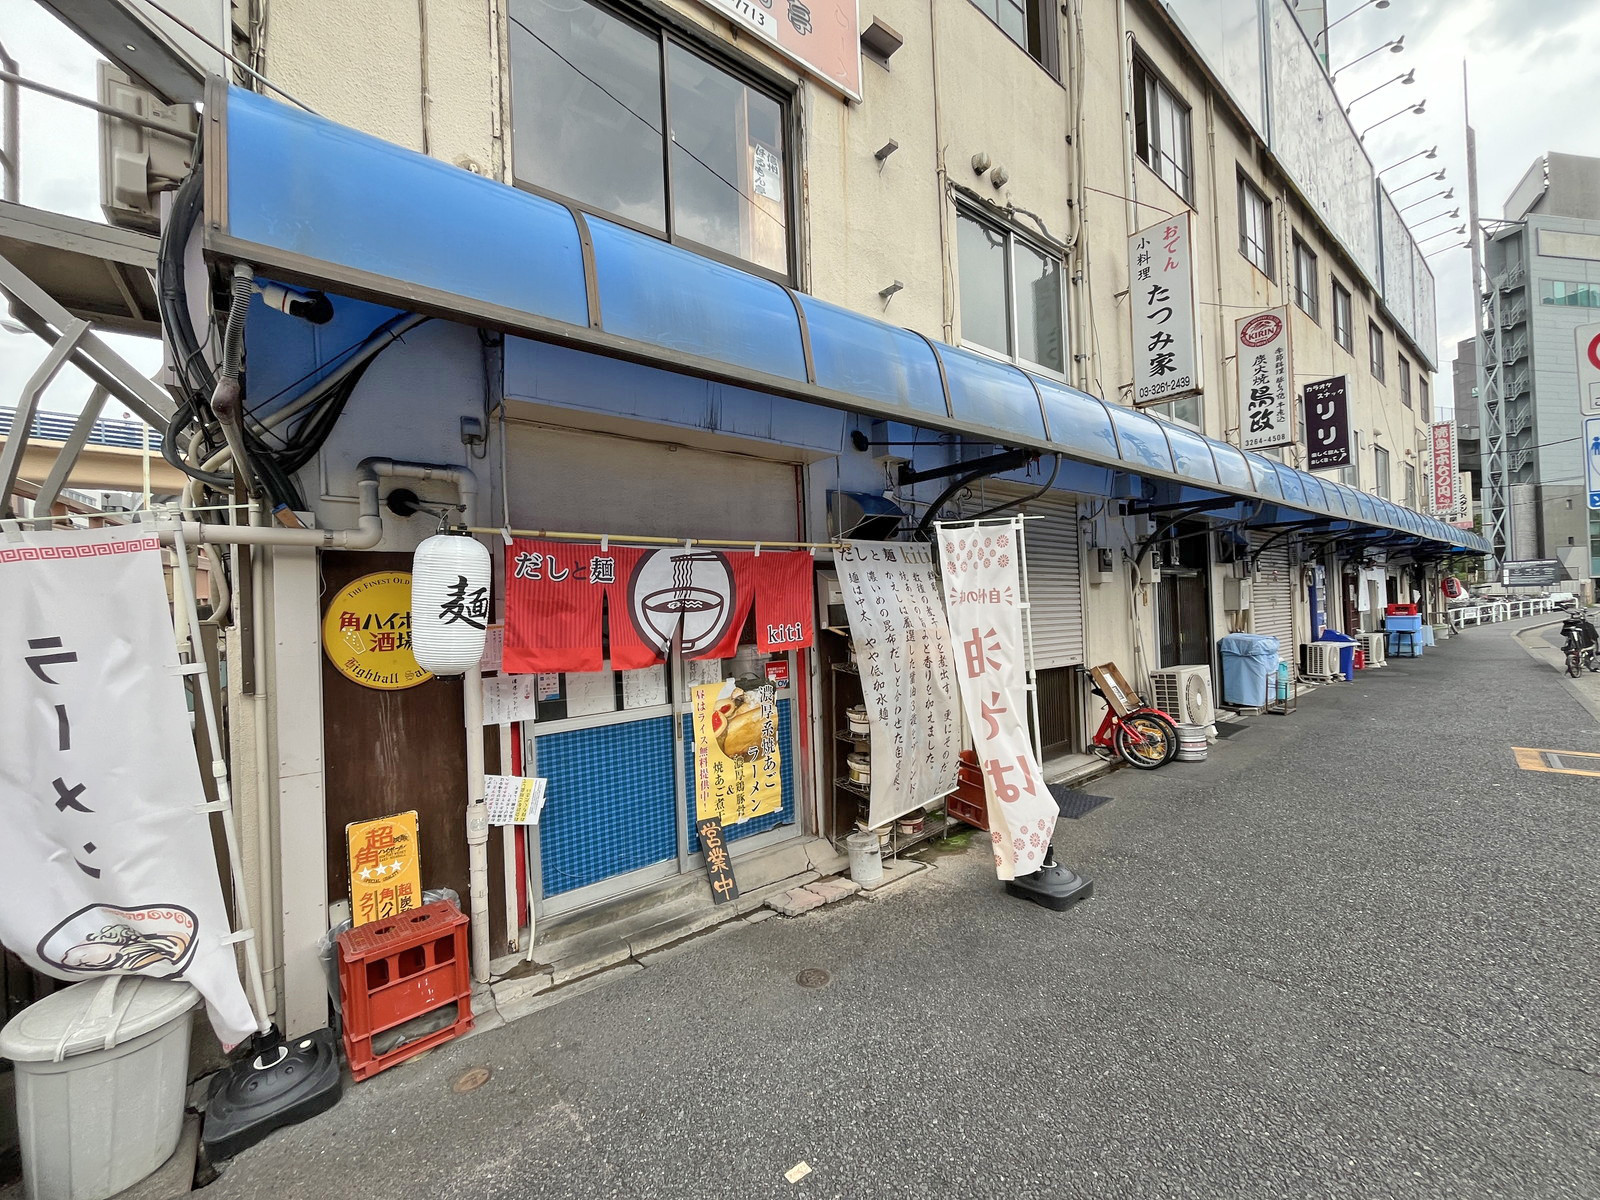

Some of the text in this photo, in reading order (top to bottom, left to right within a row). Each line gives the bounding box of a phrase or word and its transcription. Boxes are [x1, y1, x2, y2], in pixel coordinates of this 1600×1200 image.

[1136, 237, 1152, 281] 小料理
[1163, 225, 1181, 273] おでん
[1147, 284, 1177, 378] たつみ家
[1248, 327, 1275, 341] KIRIN
[1139, 375, 1191, 398] 03-3261-2439
[1306, 382, 1333, 393] カラオケ
[1317, 388, 1344, 399] スナック
[839, 545, 931, 564] だしと麺 kiti
[514, 552, 615, 585] だしと麺
[347, 577, 410, 599] THE FINEST OLD
[439, 575, 488, 630] 麺
[767, 621, 804, 644] kiti
[344, 657, 399, 684] Highball
[25, 636, 101, 879] ラーメン
[726, 784, 735, 796] &
[747, 744, 763, 812] ラーメン
[700, 821, 733, 900] 営業中
